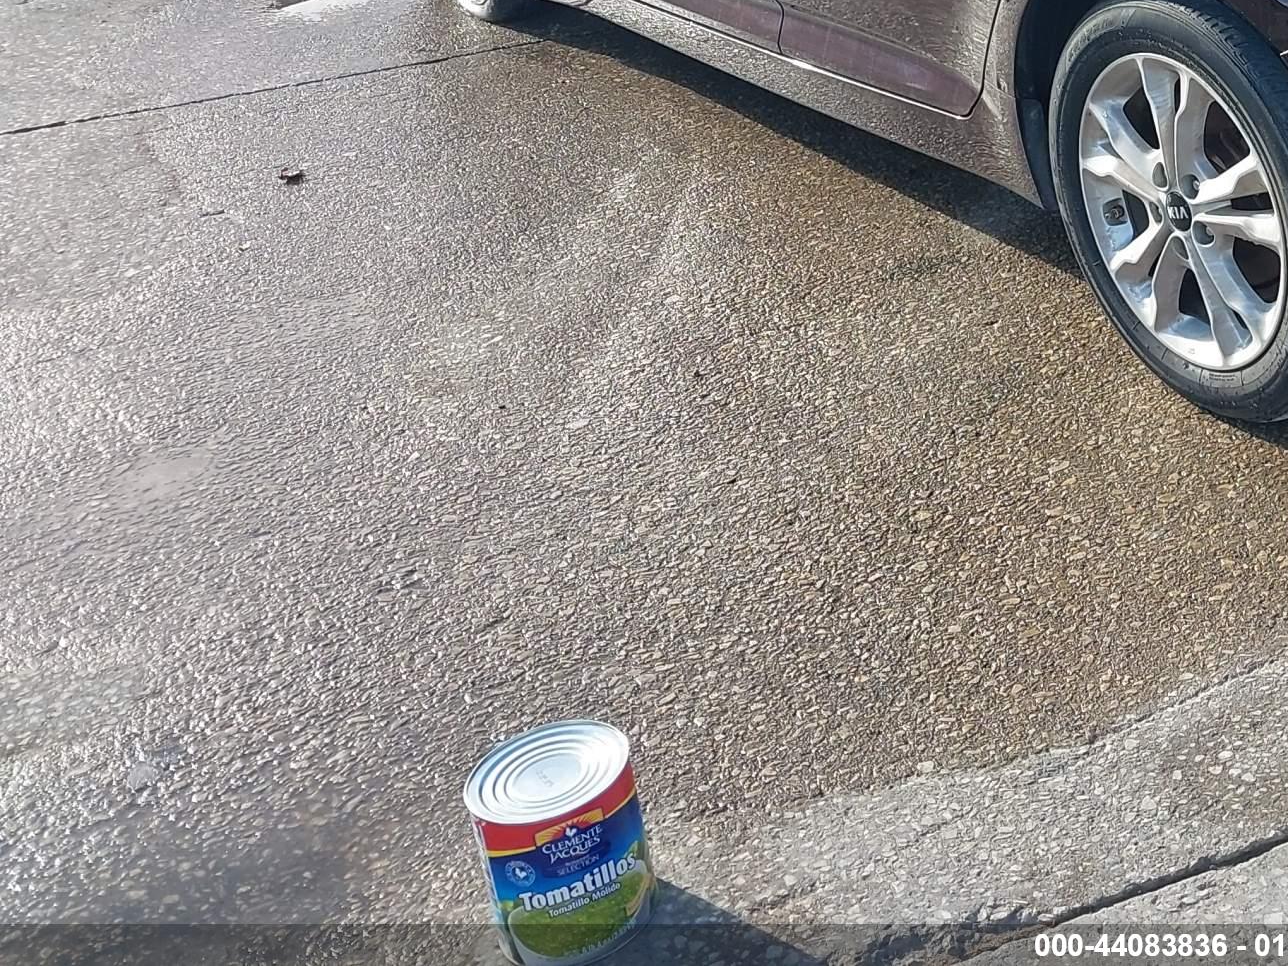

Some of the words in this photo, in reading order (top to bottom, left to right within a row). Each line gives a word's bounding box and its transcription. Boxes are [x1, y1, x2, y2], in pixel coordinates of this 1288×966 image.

[1167, 206, 1189, 219] KIA
[542, 823, 604, 854] CLEMENTE
[550, 835, 601, 864] JACQUES
[518, 852, 638, 912] Tomatillos
[548, 896, 590, 918] Tomatillo
[591, 882, 621, 902] Molido
